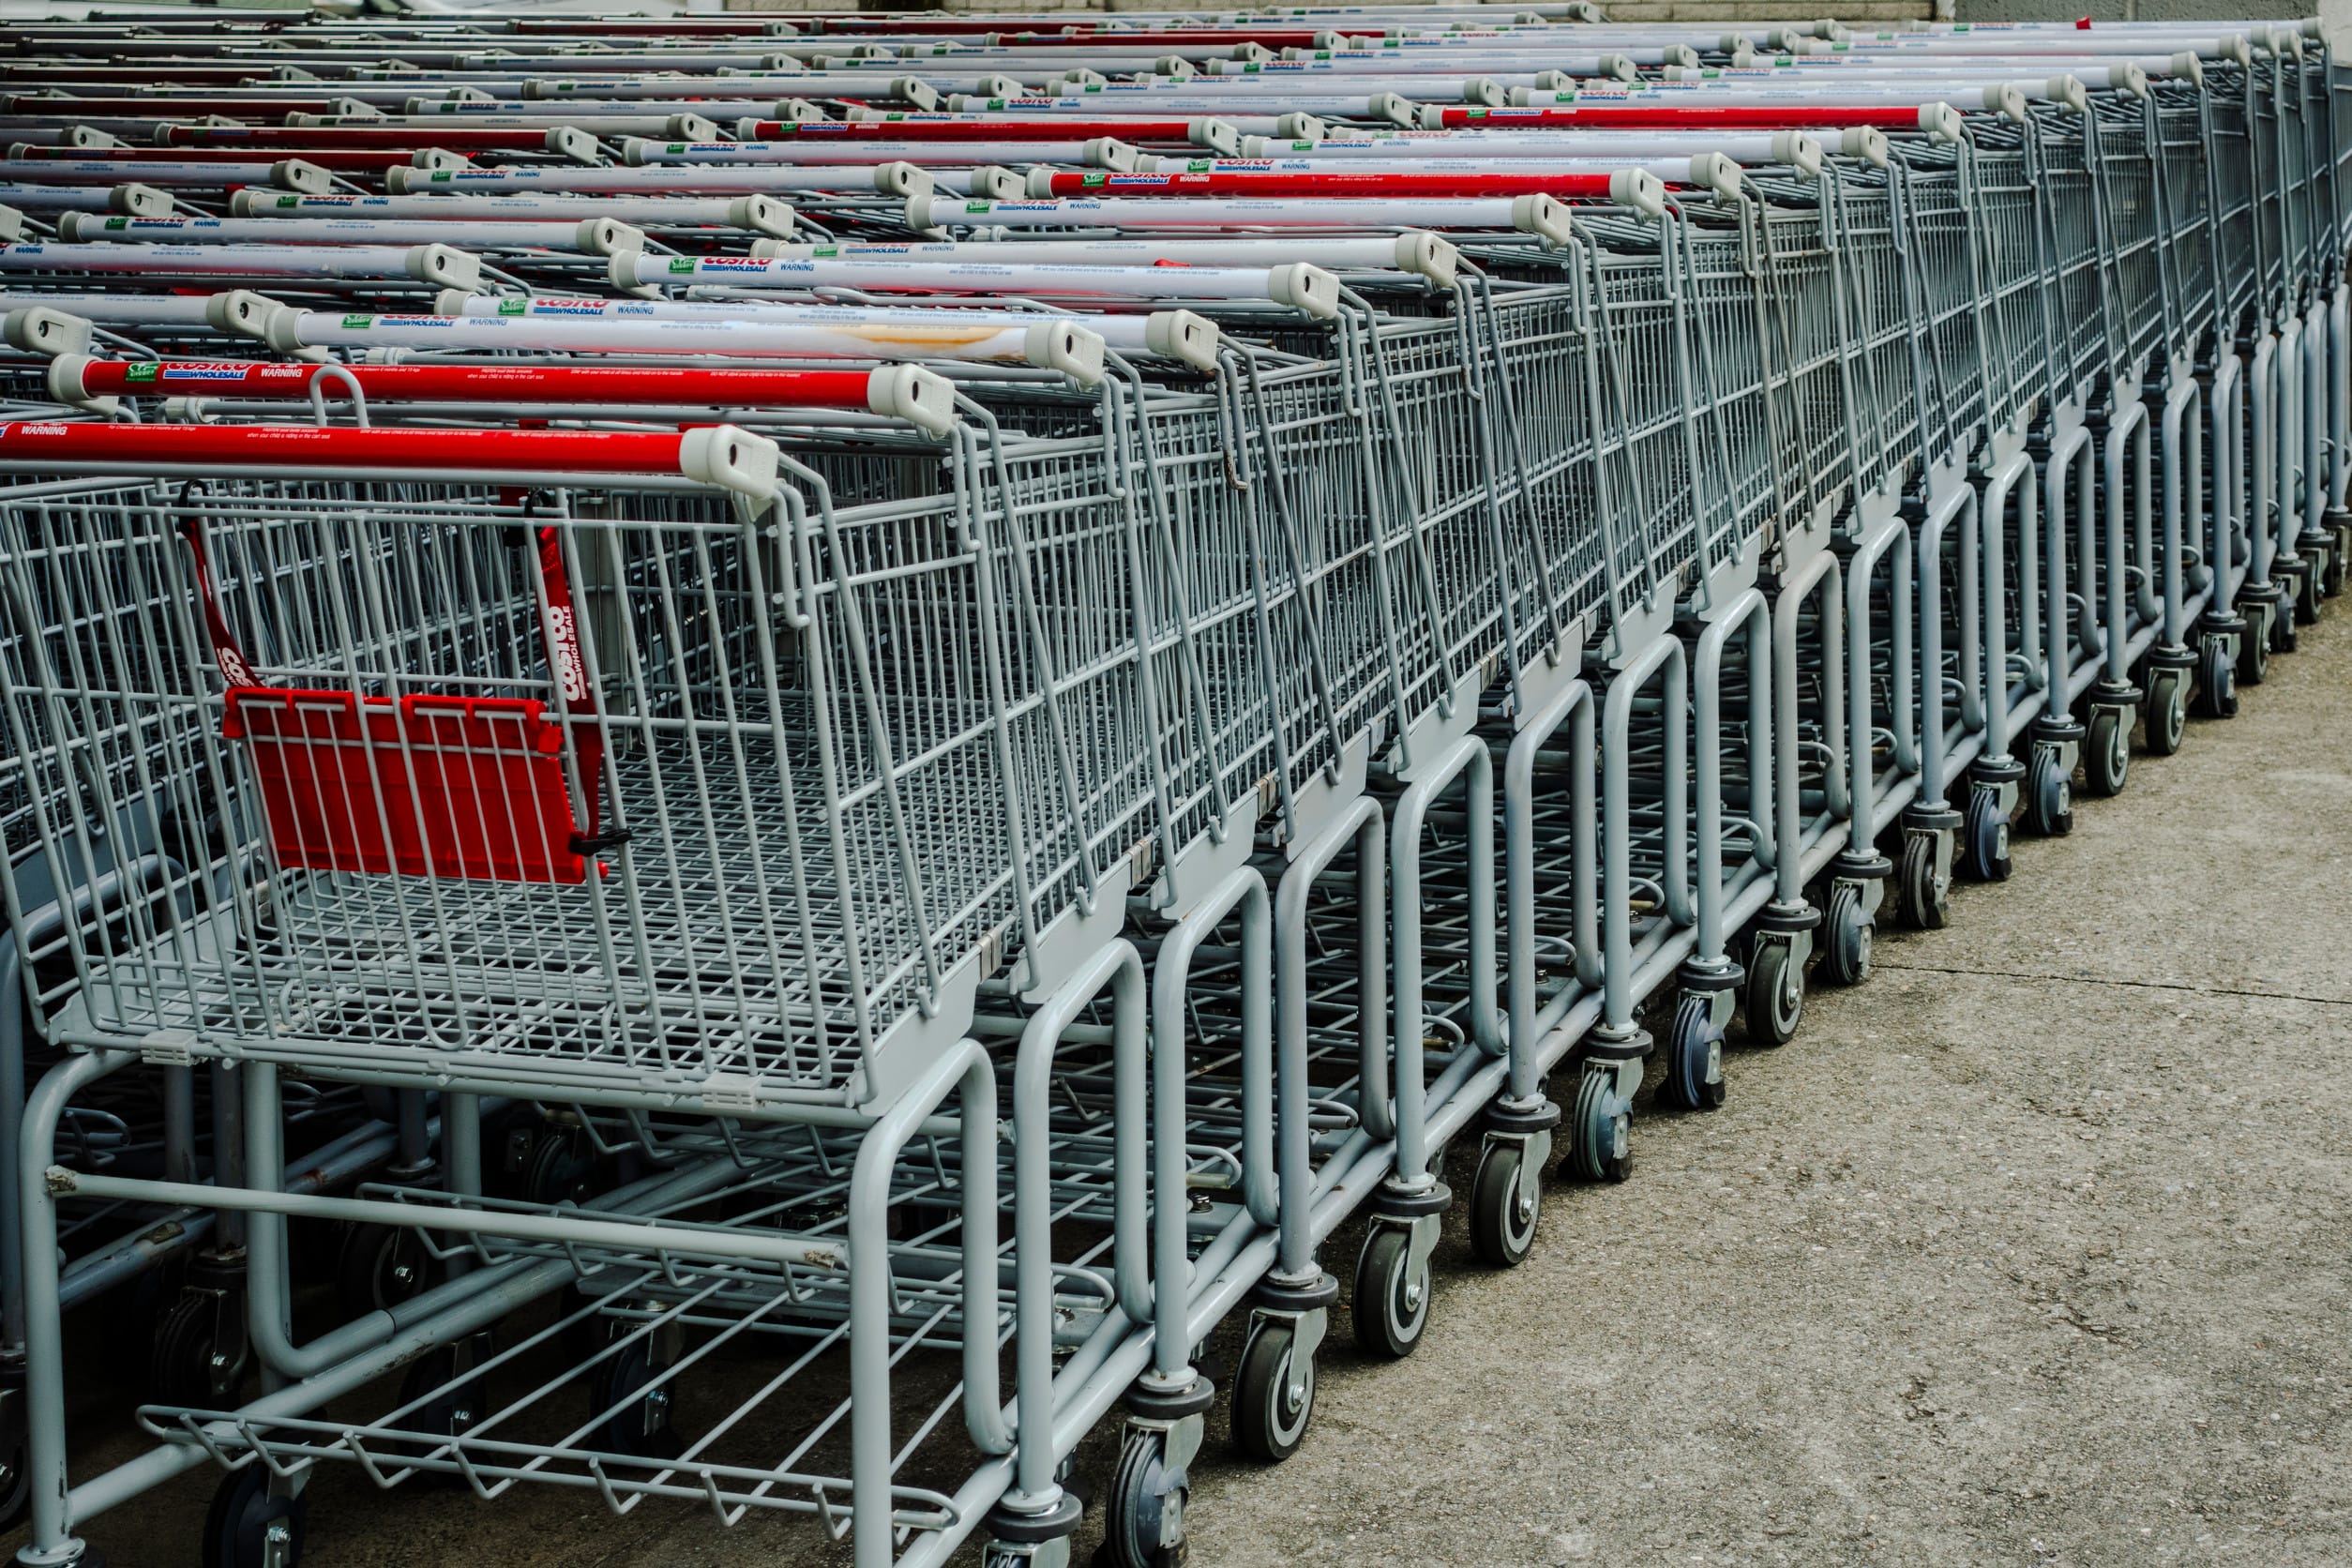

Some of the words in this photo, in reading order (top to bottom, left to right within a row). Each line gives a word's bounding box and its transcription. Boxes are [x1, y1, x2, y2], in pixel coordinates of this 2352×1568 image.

[617, 306, 654, 315] WARNING
[469, 318, 508, 326] WARNING
[188, 370, 247, 379] WHOLESALE
[261, 369, 303, 377] WARNING
[22, 426, 68, 436] WARNING
[563, 606, 582, 673] WHOLESALE
